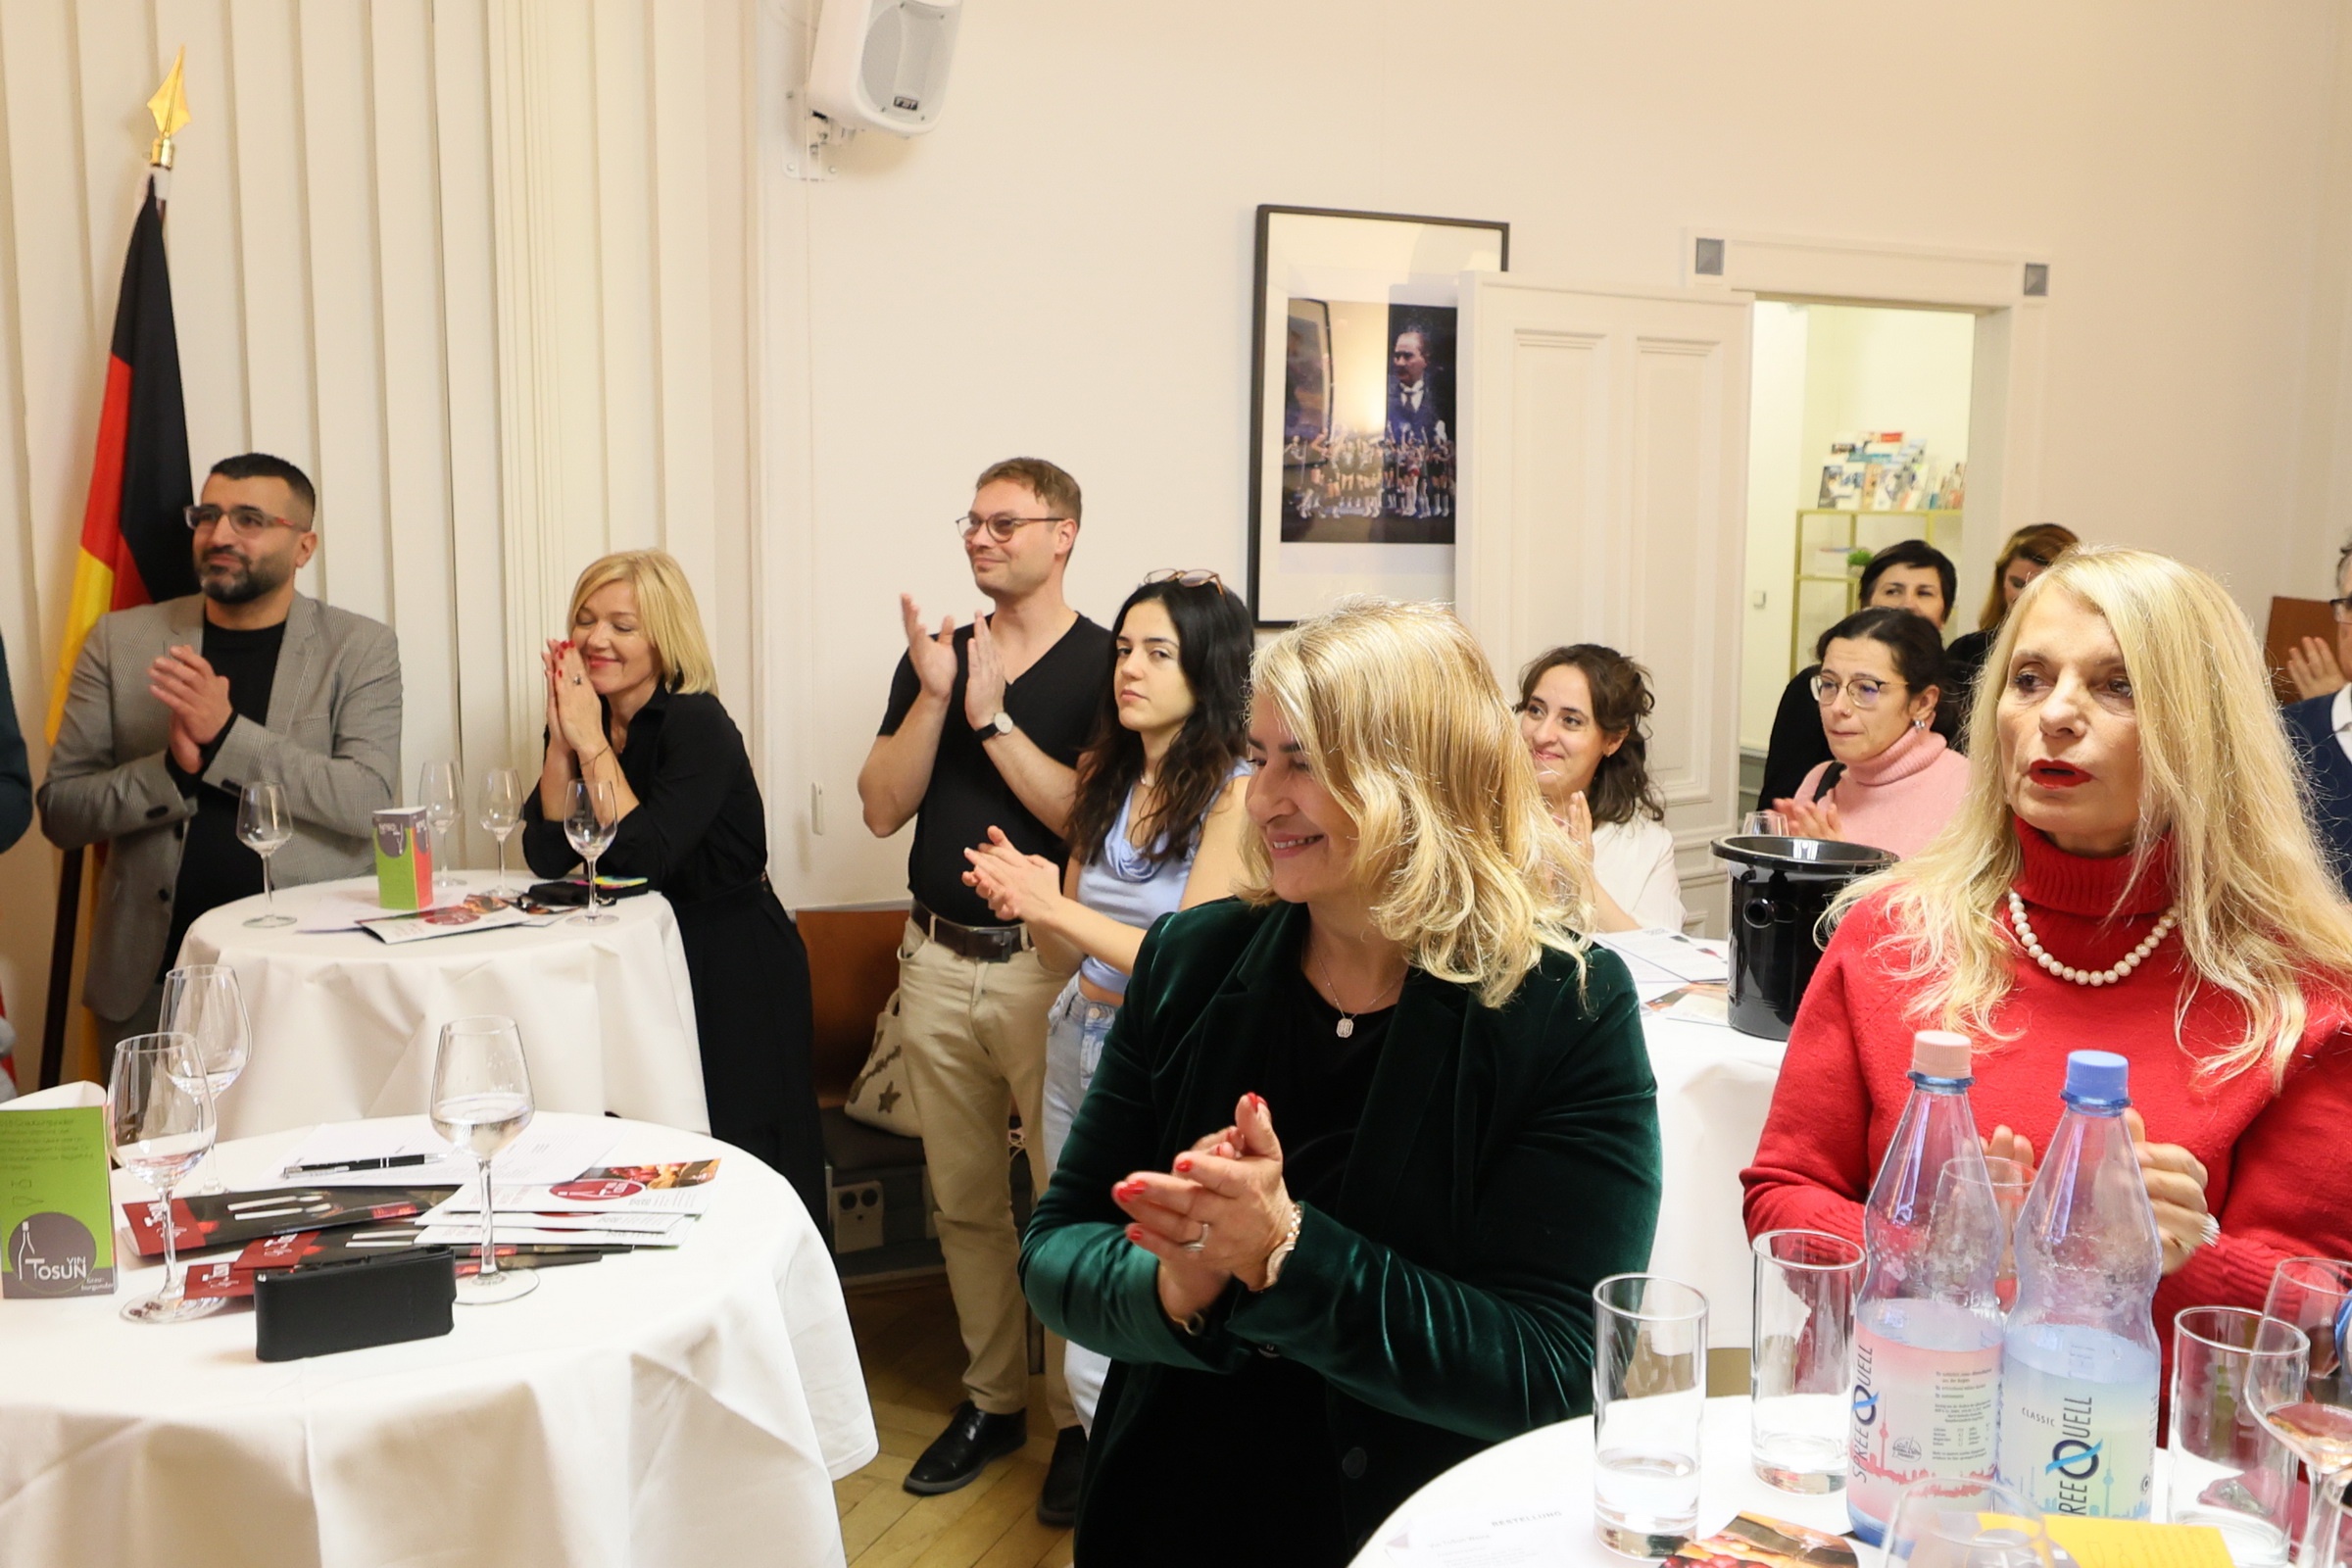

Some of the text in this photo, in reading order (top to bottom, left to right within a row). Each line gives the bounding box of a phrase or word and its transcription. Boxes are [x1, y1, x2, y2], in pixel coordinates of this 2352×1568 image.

[2022, 1407, 2055, 1428] CLASSIC
[2049, 1396, 2101, 1516] REEQUELL
[1492, 1511, 1562, 1527] BESTELLUNG
